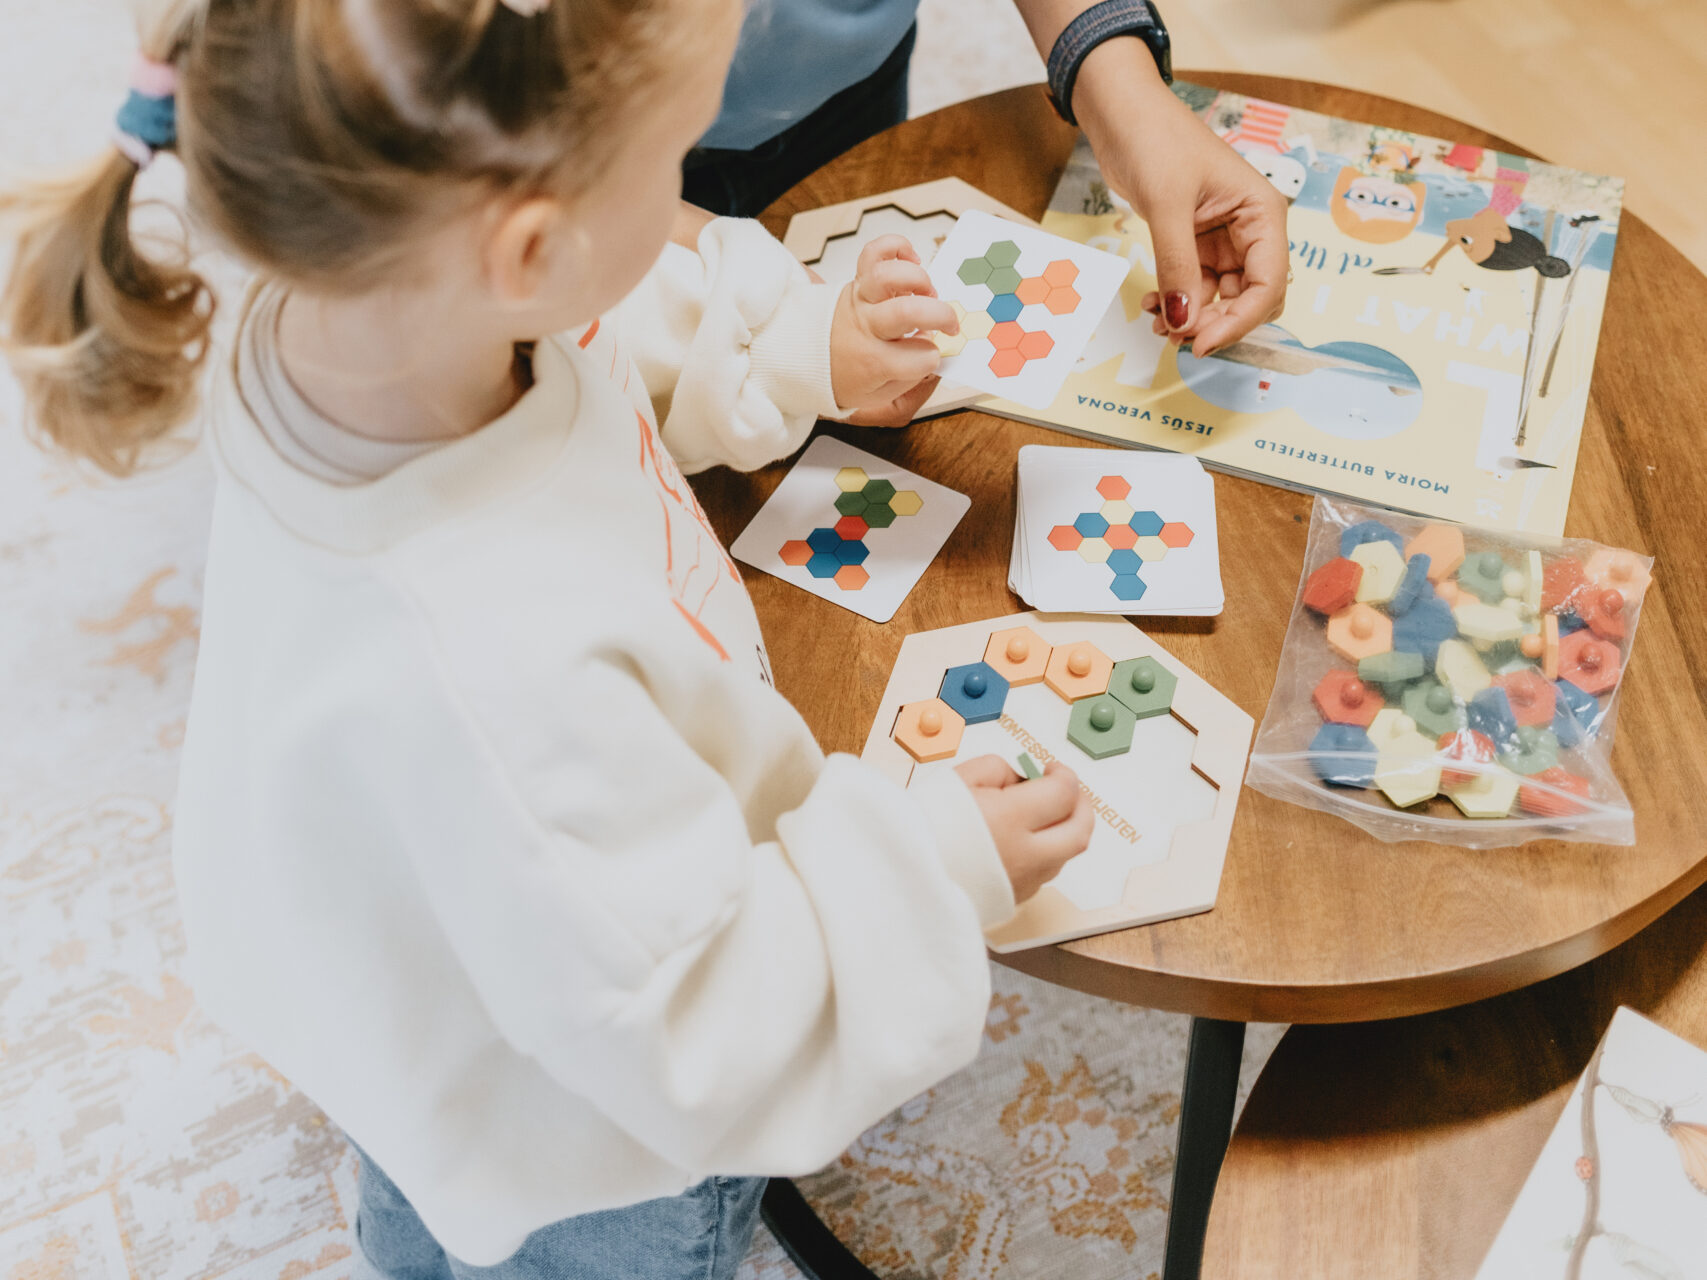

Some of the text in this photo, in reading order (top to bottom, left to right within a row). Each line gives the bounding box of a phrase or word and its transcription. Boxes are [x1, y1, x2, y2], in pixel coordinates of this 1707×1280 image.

[1339, 252, 1373, 274] at
[1313, 284, 1530, 360] WHAT I
[1077, 394, 1215, 438] JESÚS VERONA
[1254, 438, 1450, 495] MOIRA BUTTERFIELD
[997, 713, 1143, 844] ONTESSO RNWELTEN
